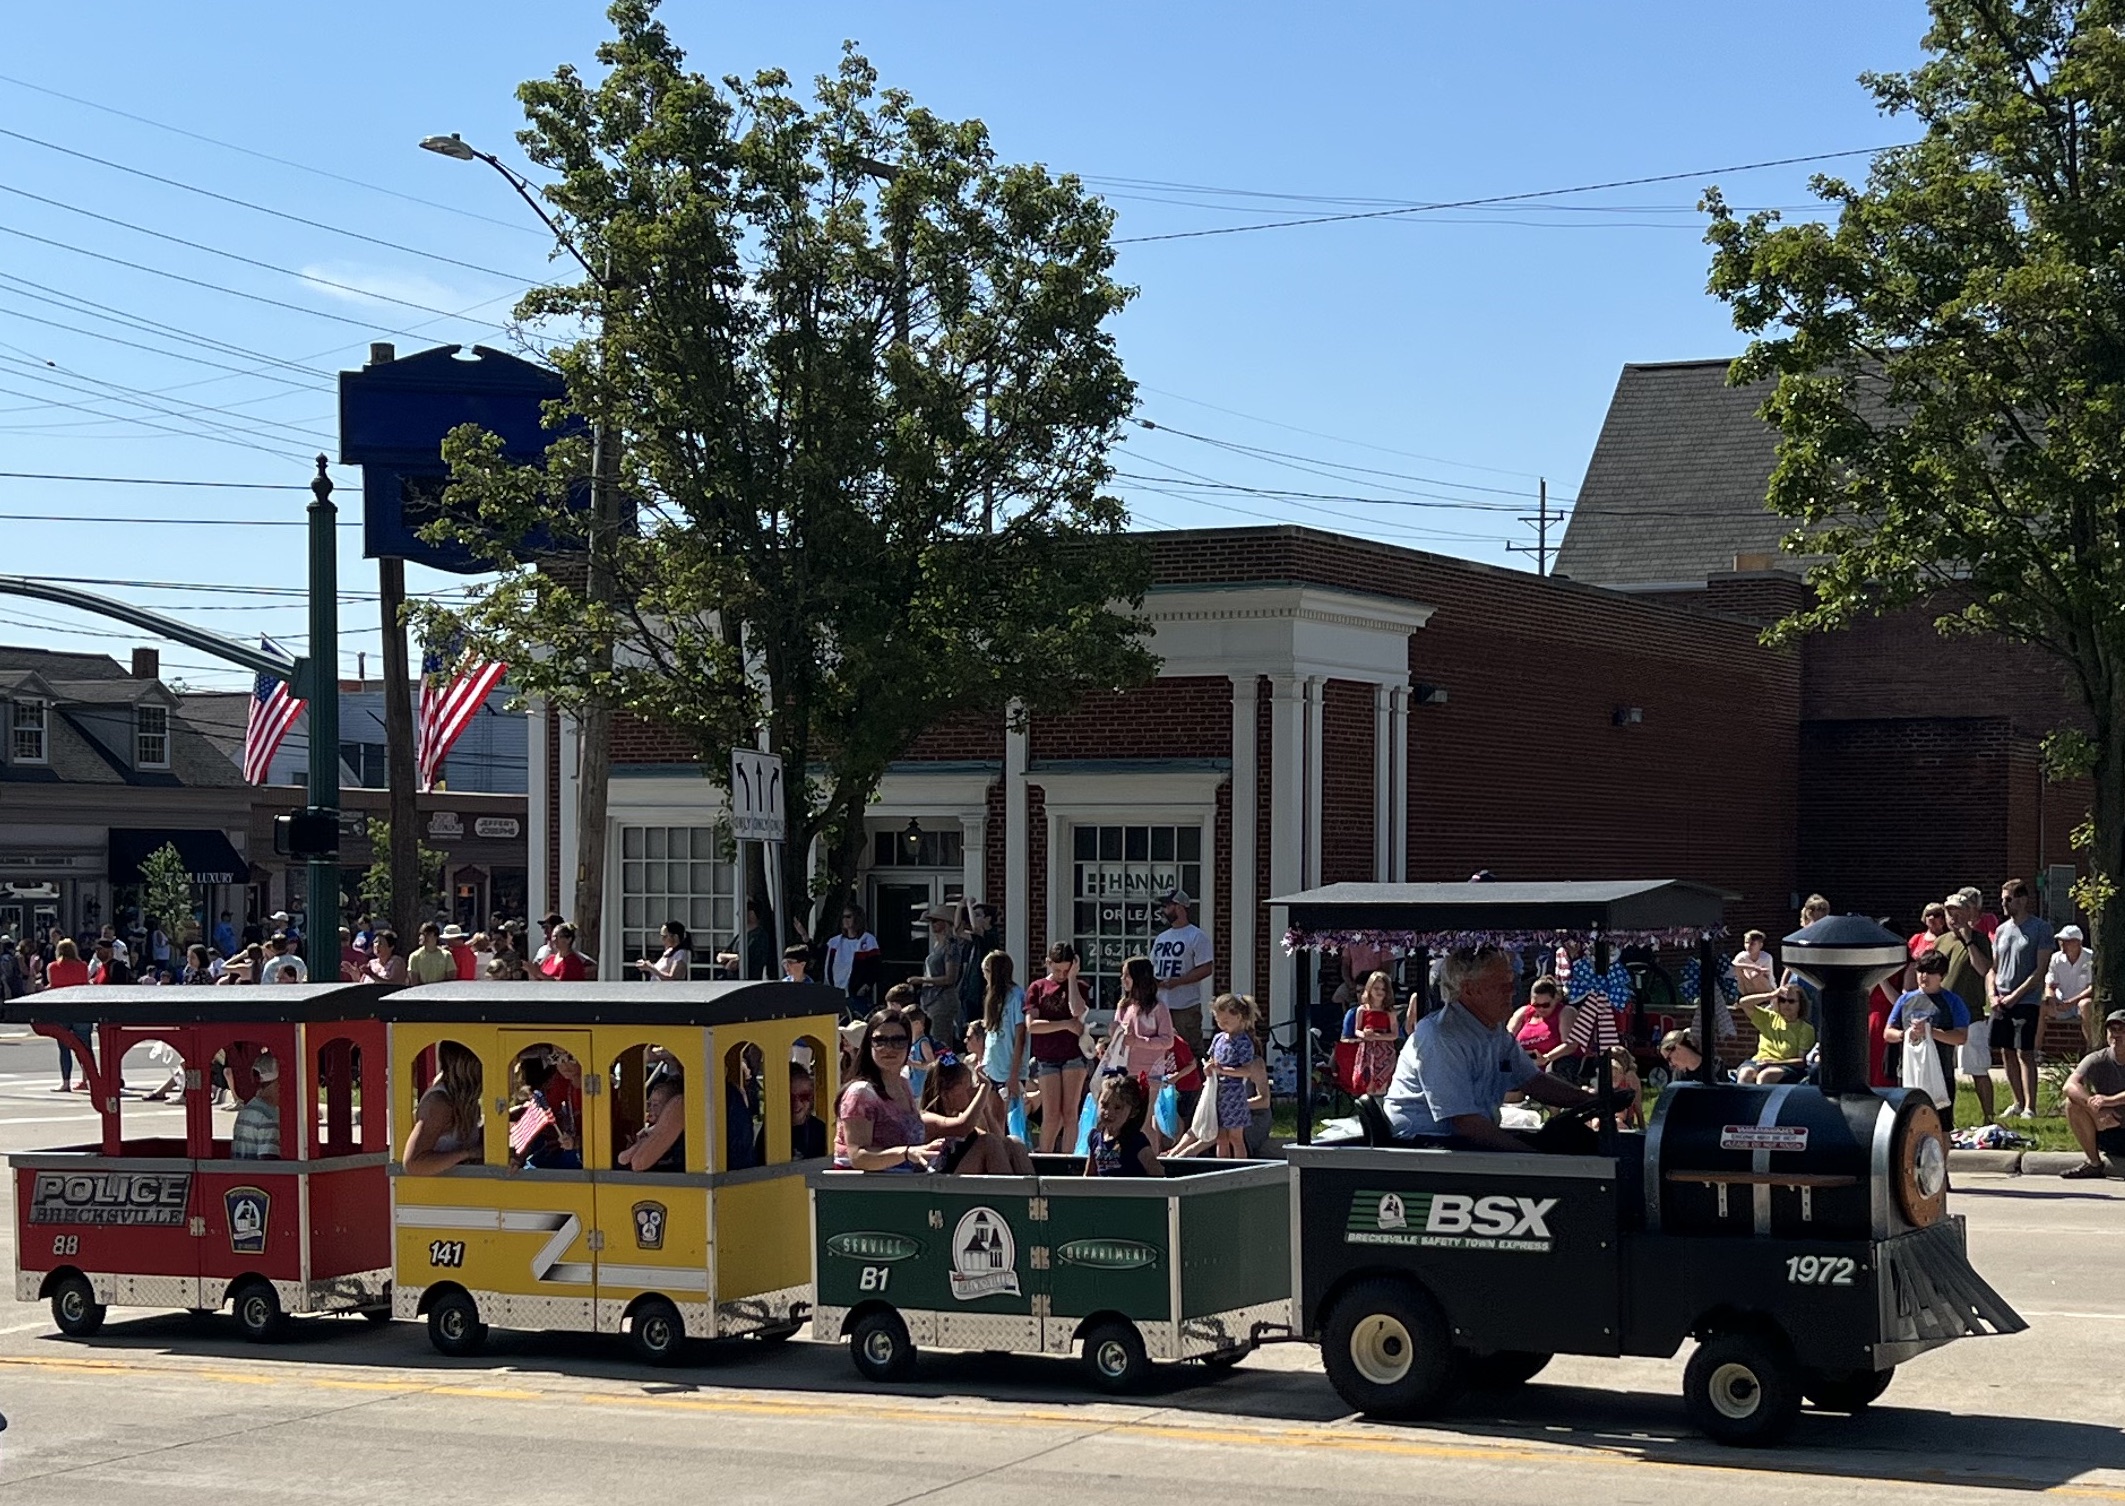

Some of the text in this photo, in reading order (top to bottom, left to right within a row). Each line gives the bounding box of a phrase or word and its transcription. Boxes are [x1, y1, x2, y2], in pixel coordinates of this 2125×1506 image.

[197, 872, 234, 884] LUXURY
[1109, 873, 1174, 890] HANNA
[1102, 908, 1162, 922] OR LEAS
[1155, 941, 1185, 957] PRO
[34, 1175, 187, 1206] POLICE
[36, 1207, 183, 1224] BRECKSVILLE
[1426, 1194, 1561, 1237] BSX
[52, 1234, 79, 1256] 88
[842, 1237, 901, 1255] SERVICE
[1347, 1232, 1550, 1251] BRECKSVILLE SAFETY TOWN EXPRESS
[429, 1241, 465, 1267] 141
[1066, 1246, 1147, 1261] DEPARTMENT
[859, 1266, 889, 1291] B1
[1786, 1255, 1857, 1286] 1972
